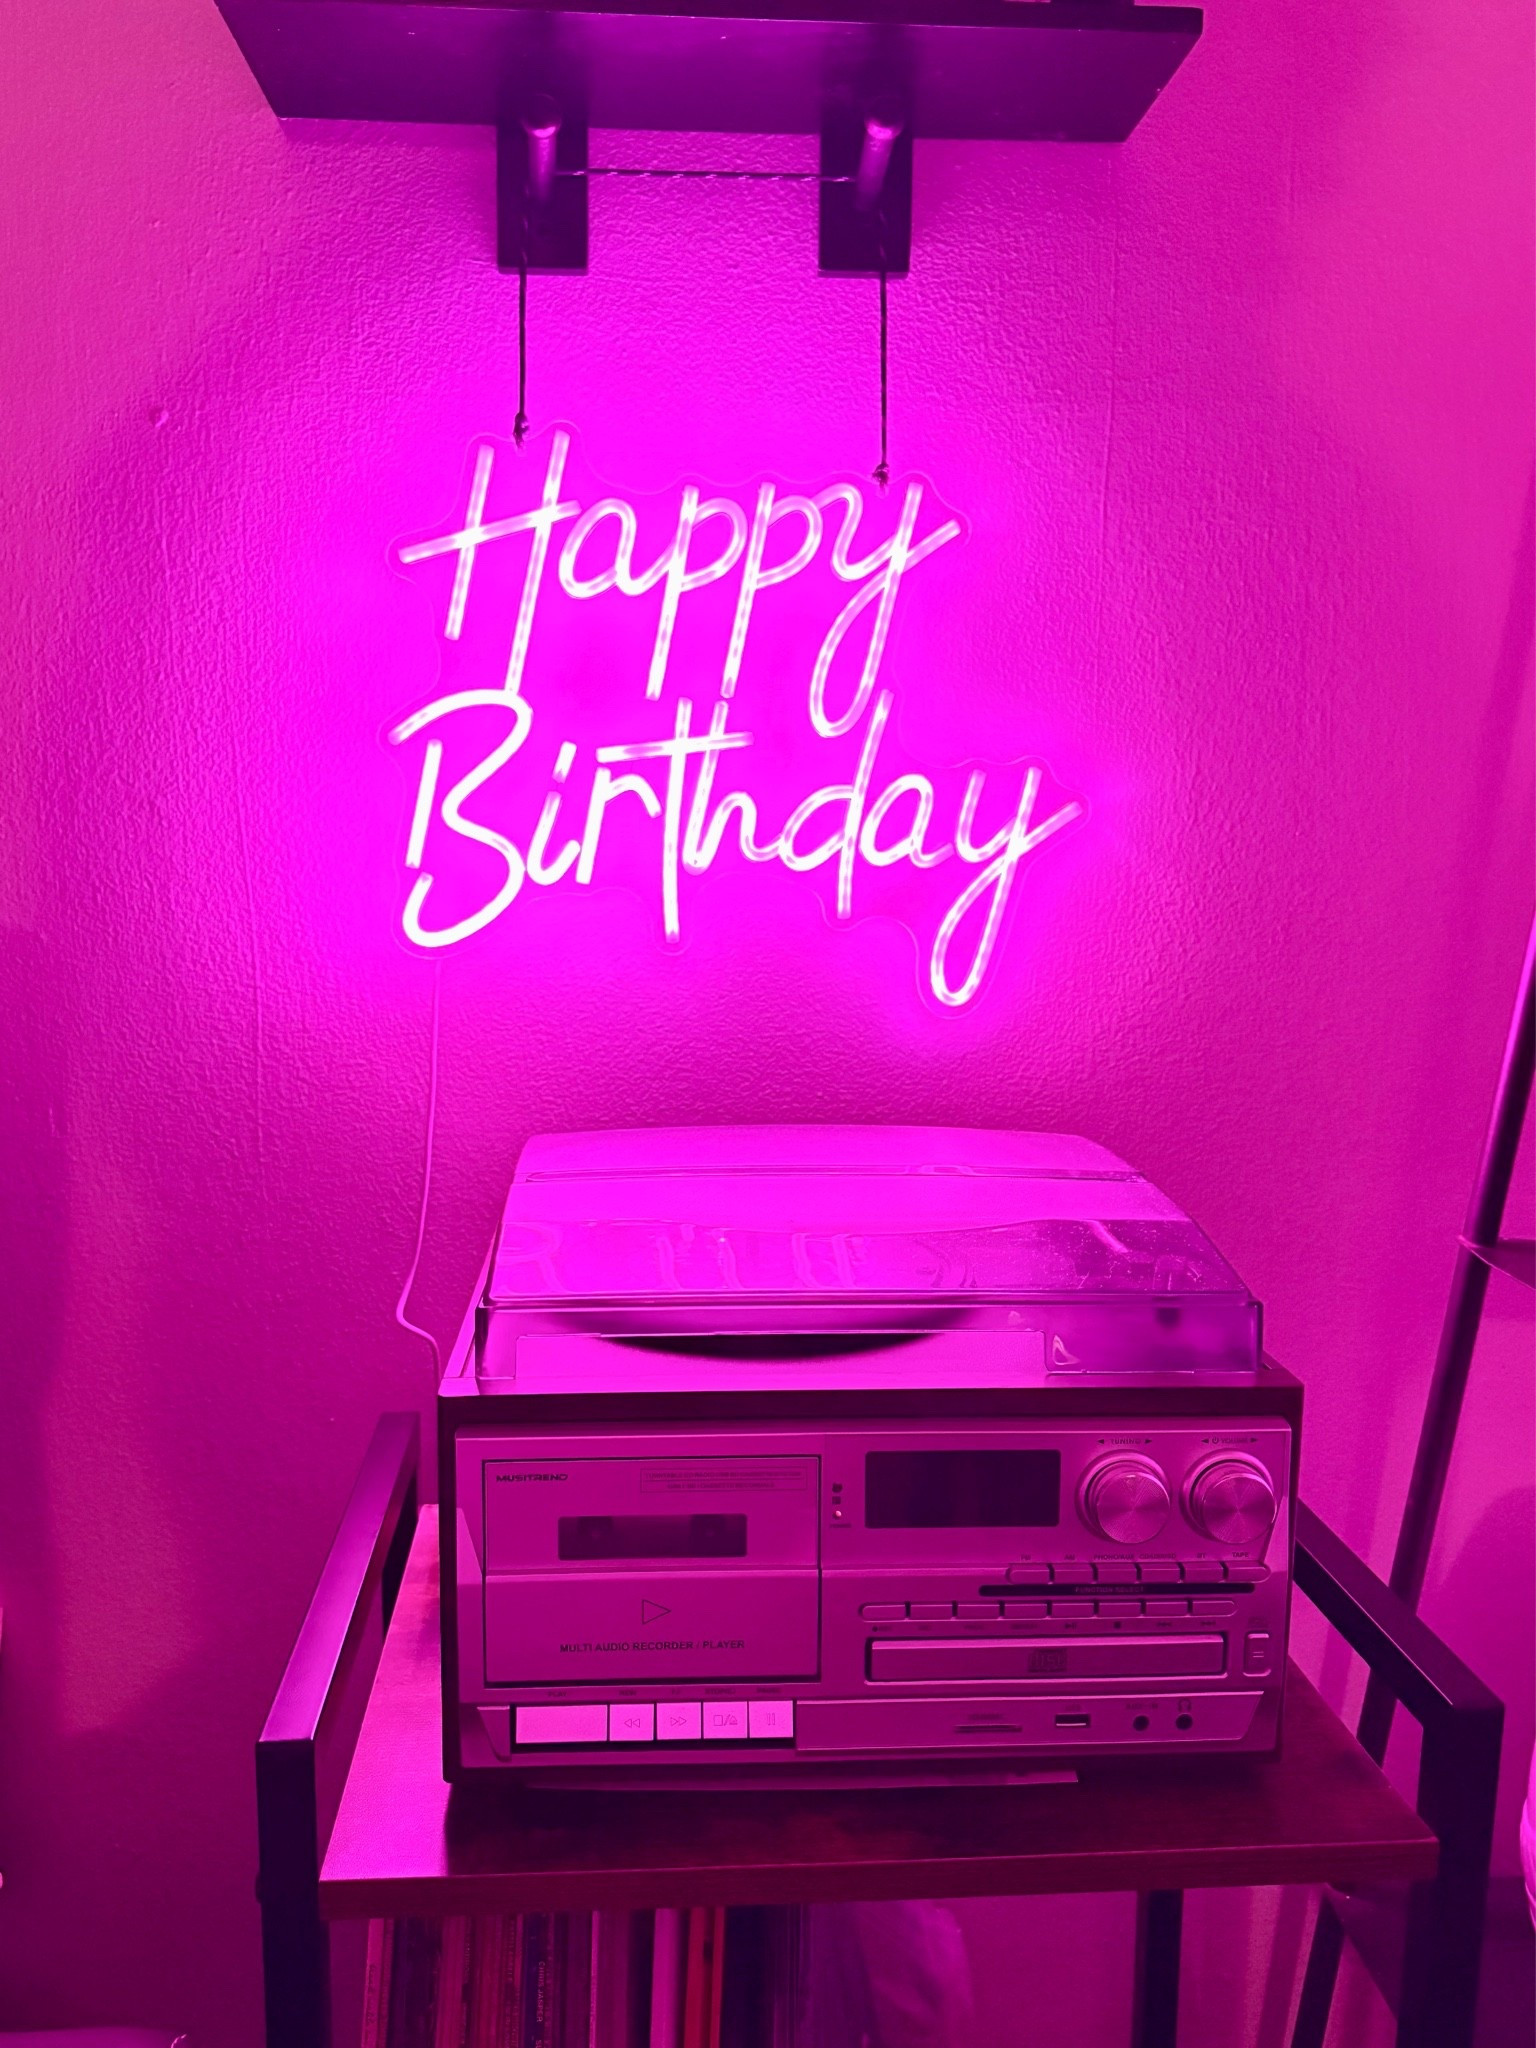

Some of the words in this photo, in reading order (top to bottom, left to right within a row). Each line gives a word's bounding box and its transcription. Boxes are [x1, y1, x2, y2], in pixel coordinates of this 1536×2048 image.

[398, 431, 961, 737] Happy
[388, 689, 1084, 1008] Birthday
[495, 1473, 569, 1483] MUSITREND
[559, 1643, 592, 1653] MULTI
[595, 1642, 629, 1652] AUDIO
[632, 1641, 694, 1651] RECORDER
[702, 1639, 745, 1650] PLAYER
[537, 1960, 546, 1988] CHRIS
[536, 1988, 545, 2023] JASPER
